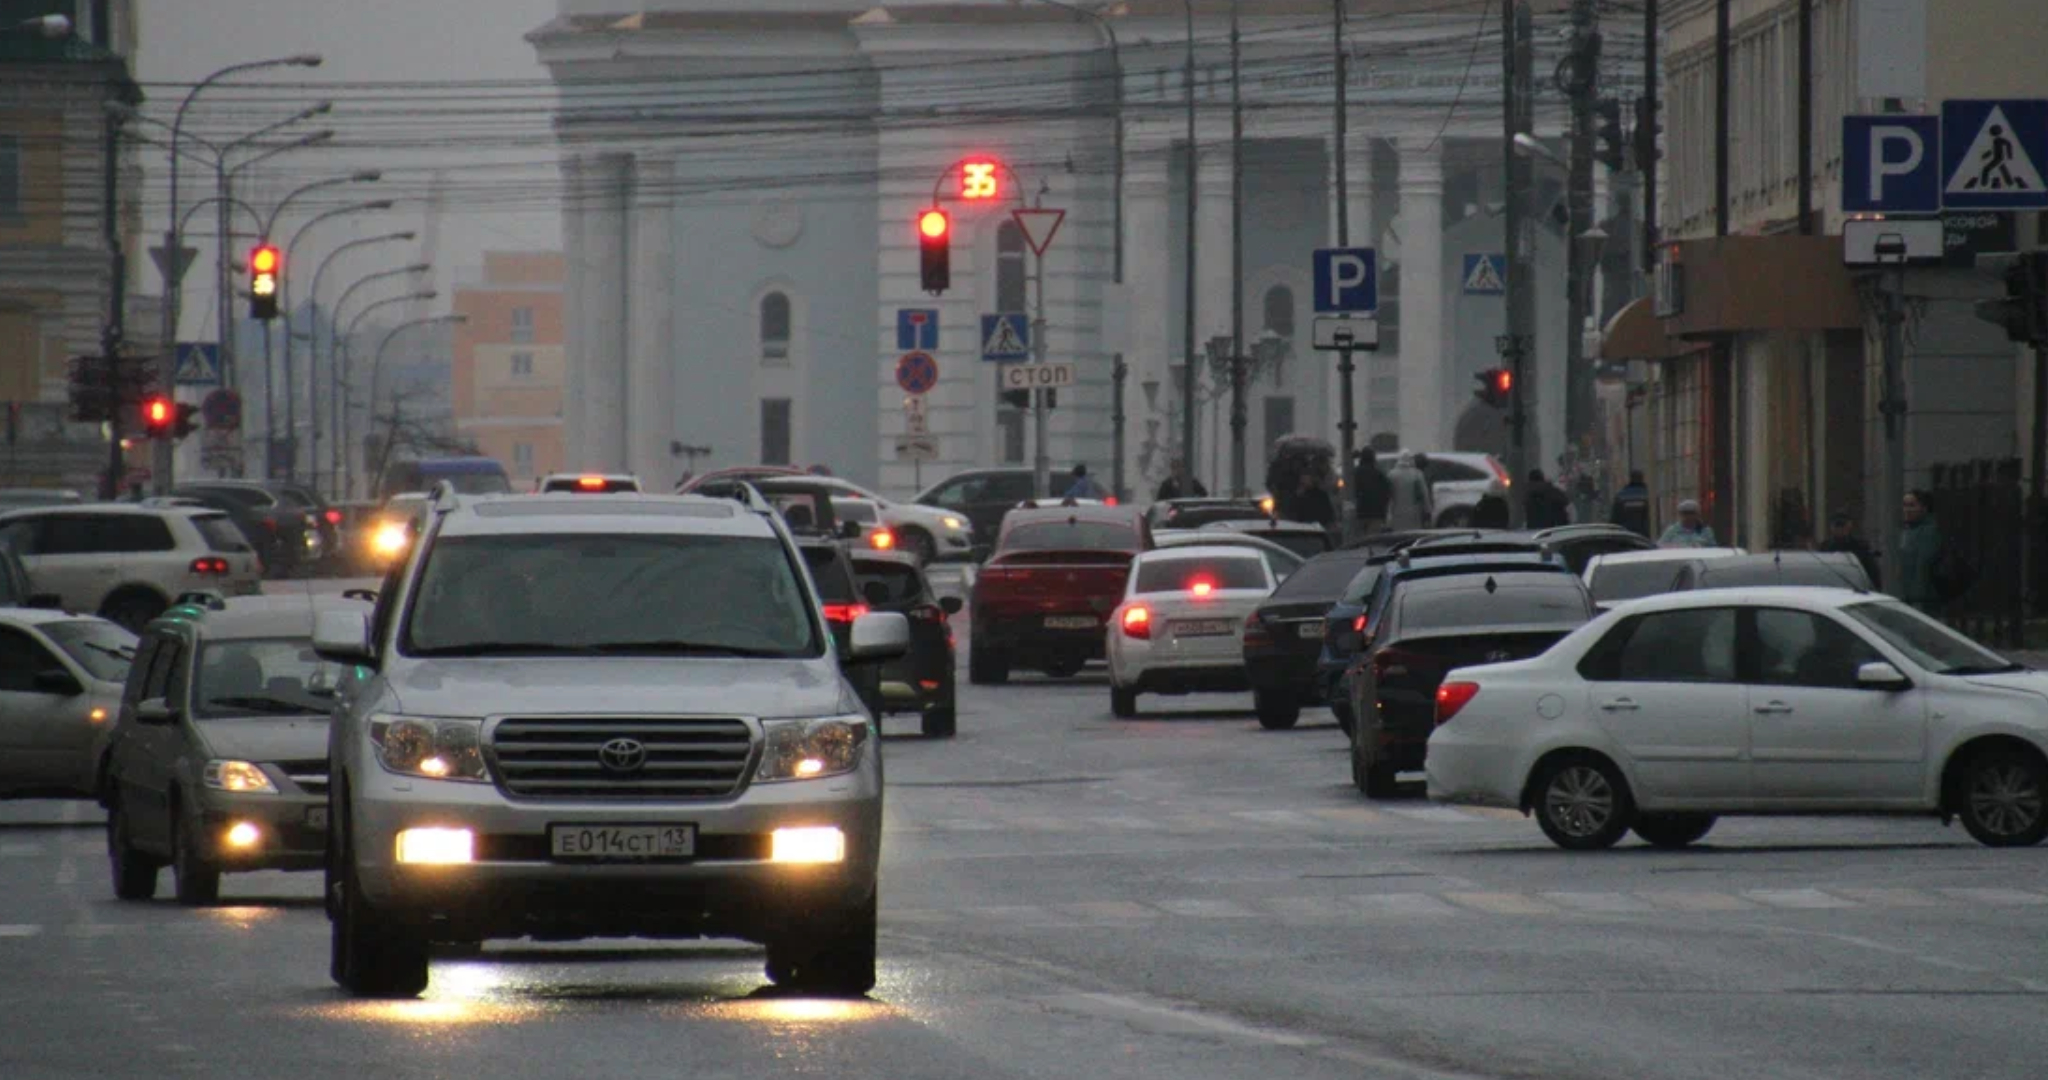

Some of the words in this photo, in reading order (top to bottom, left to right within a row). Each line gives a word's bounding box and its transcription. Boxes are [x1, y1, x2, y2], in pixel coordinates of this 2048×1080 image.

[963, 163, 997, 198] 35
[1870, 126, 1924, 200] P
[1330, 255, 1365, 305] P
[1010, 366, 1068, 385] СТОП
[663, 828, 685, 845] 13
